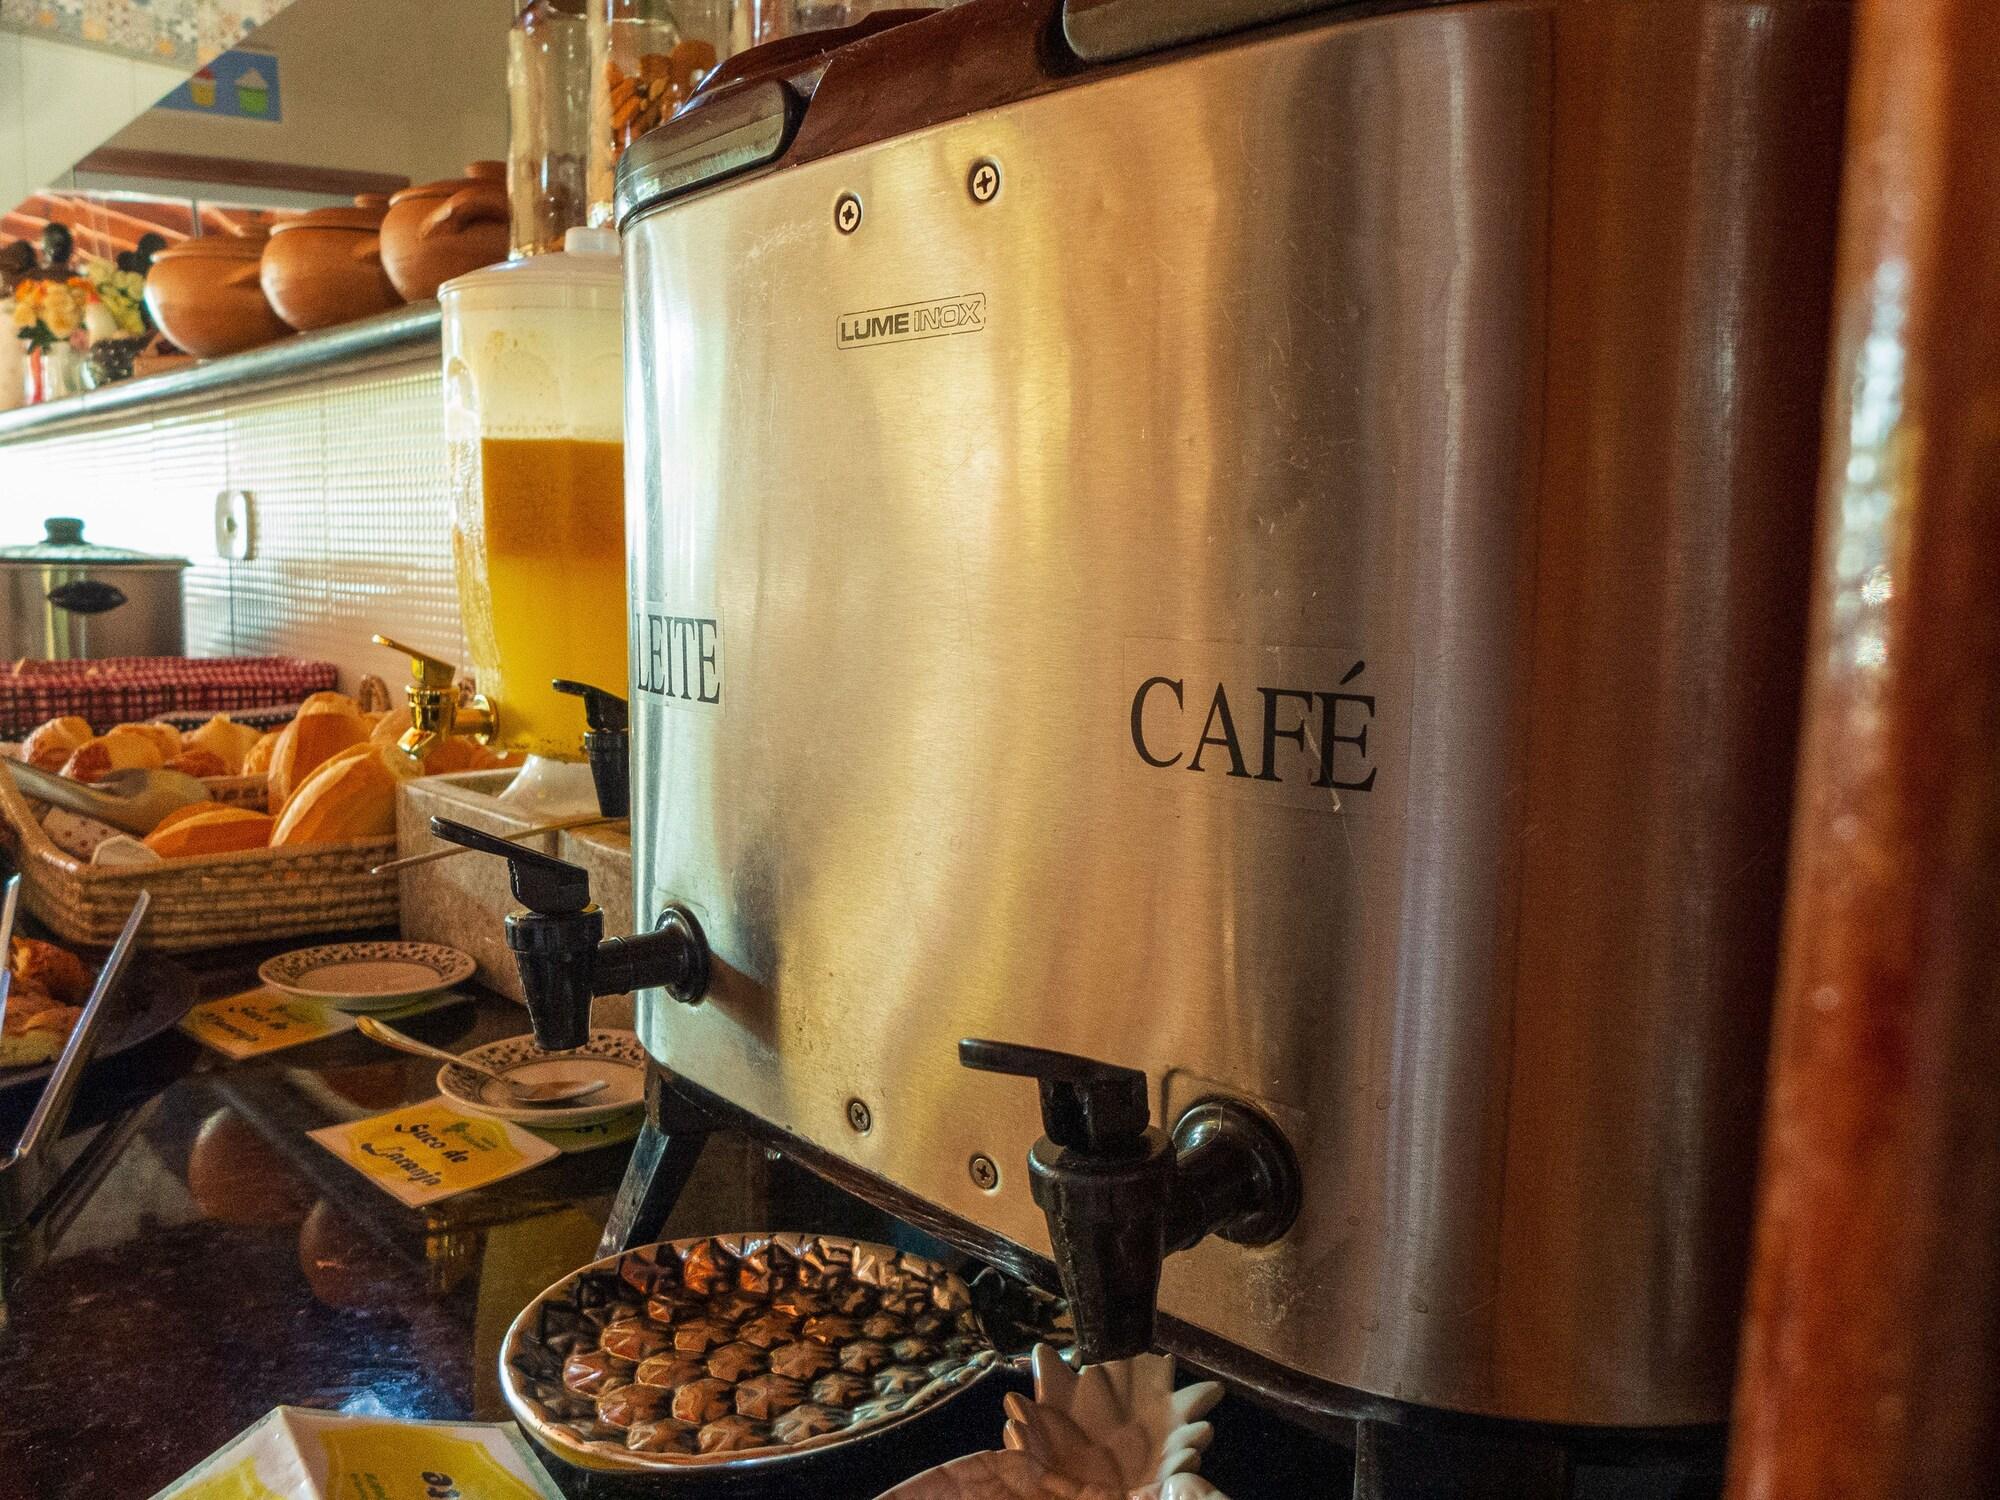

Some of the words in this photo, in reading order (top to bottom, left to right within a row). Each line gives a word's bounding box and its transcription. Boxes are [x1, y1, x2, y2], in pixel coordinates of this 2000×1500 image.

[841, 312, 910, 342] LUME
[913, 300, 982, 332] INOX
[636, 612, 720, 705] LEITE
[1130, 660, 1378, 793] CAFÉ
[360, 1142, 442, 1187] Laranja
[394, 1123, 447, 1150] Suco
[443, 1150, 469, 1164] de
